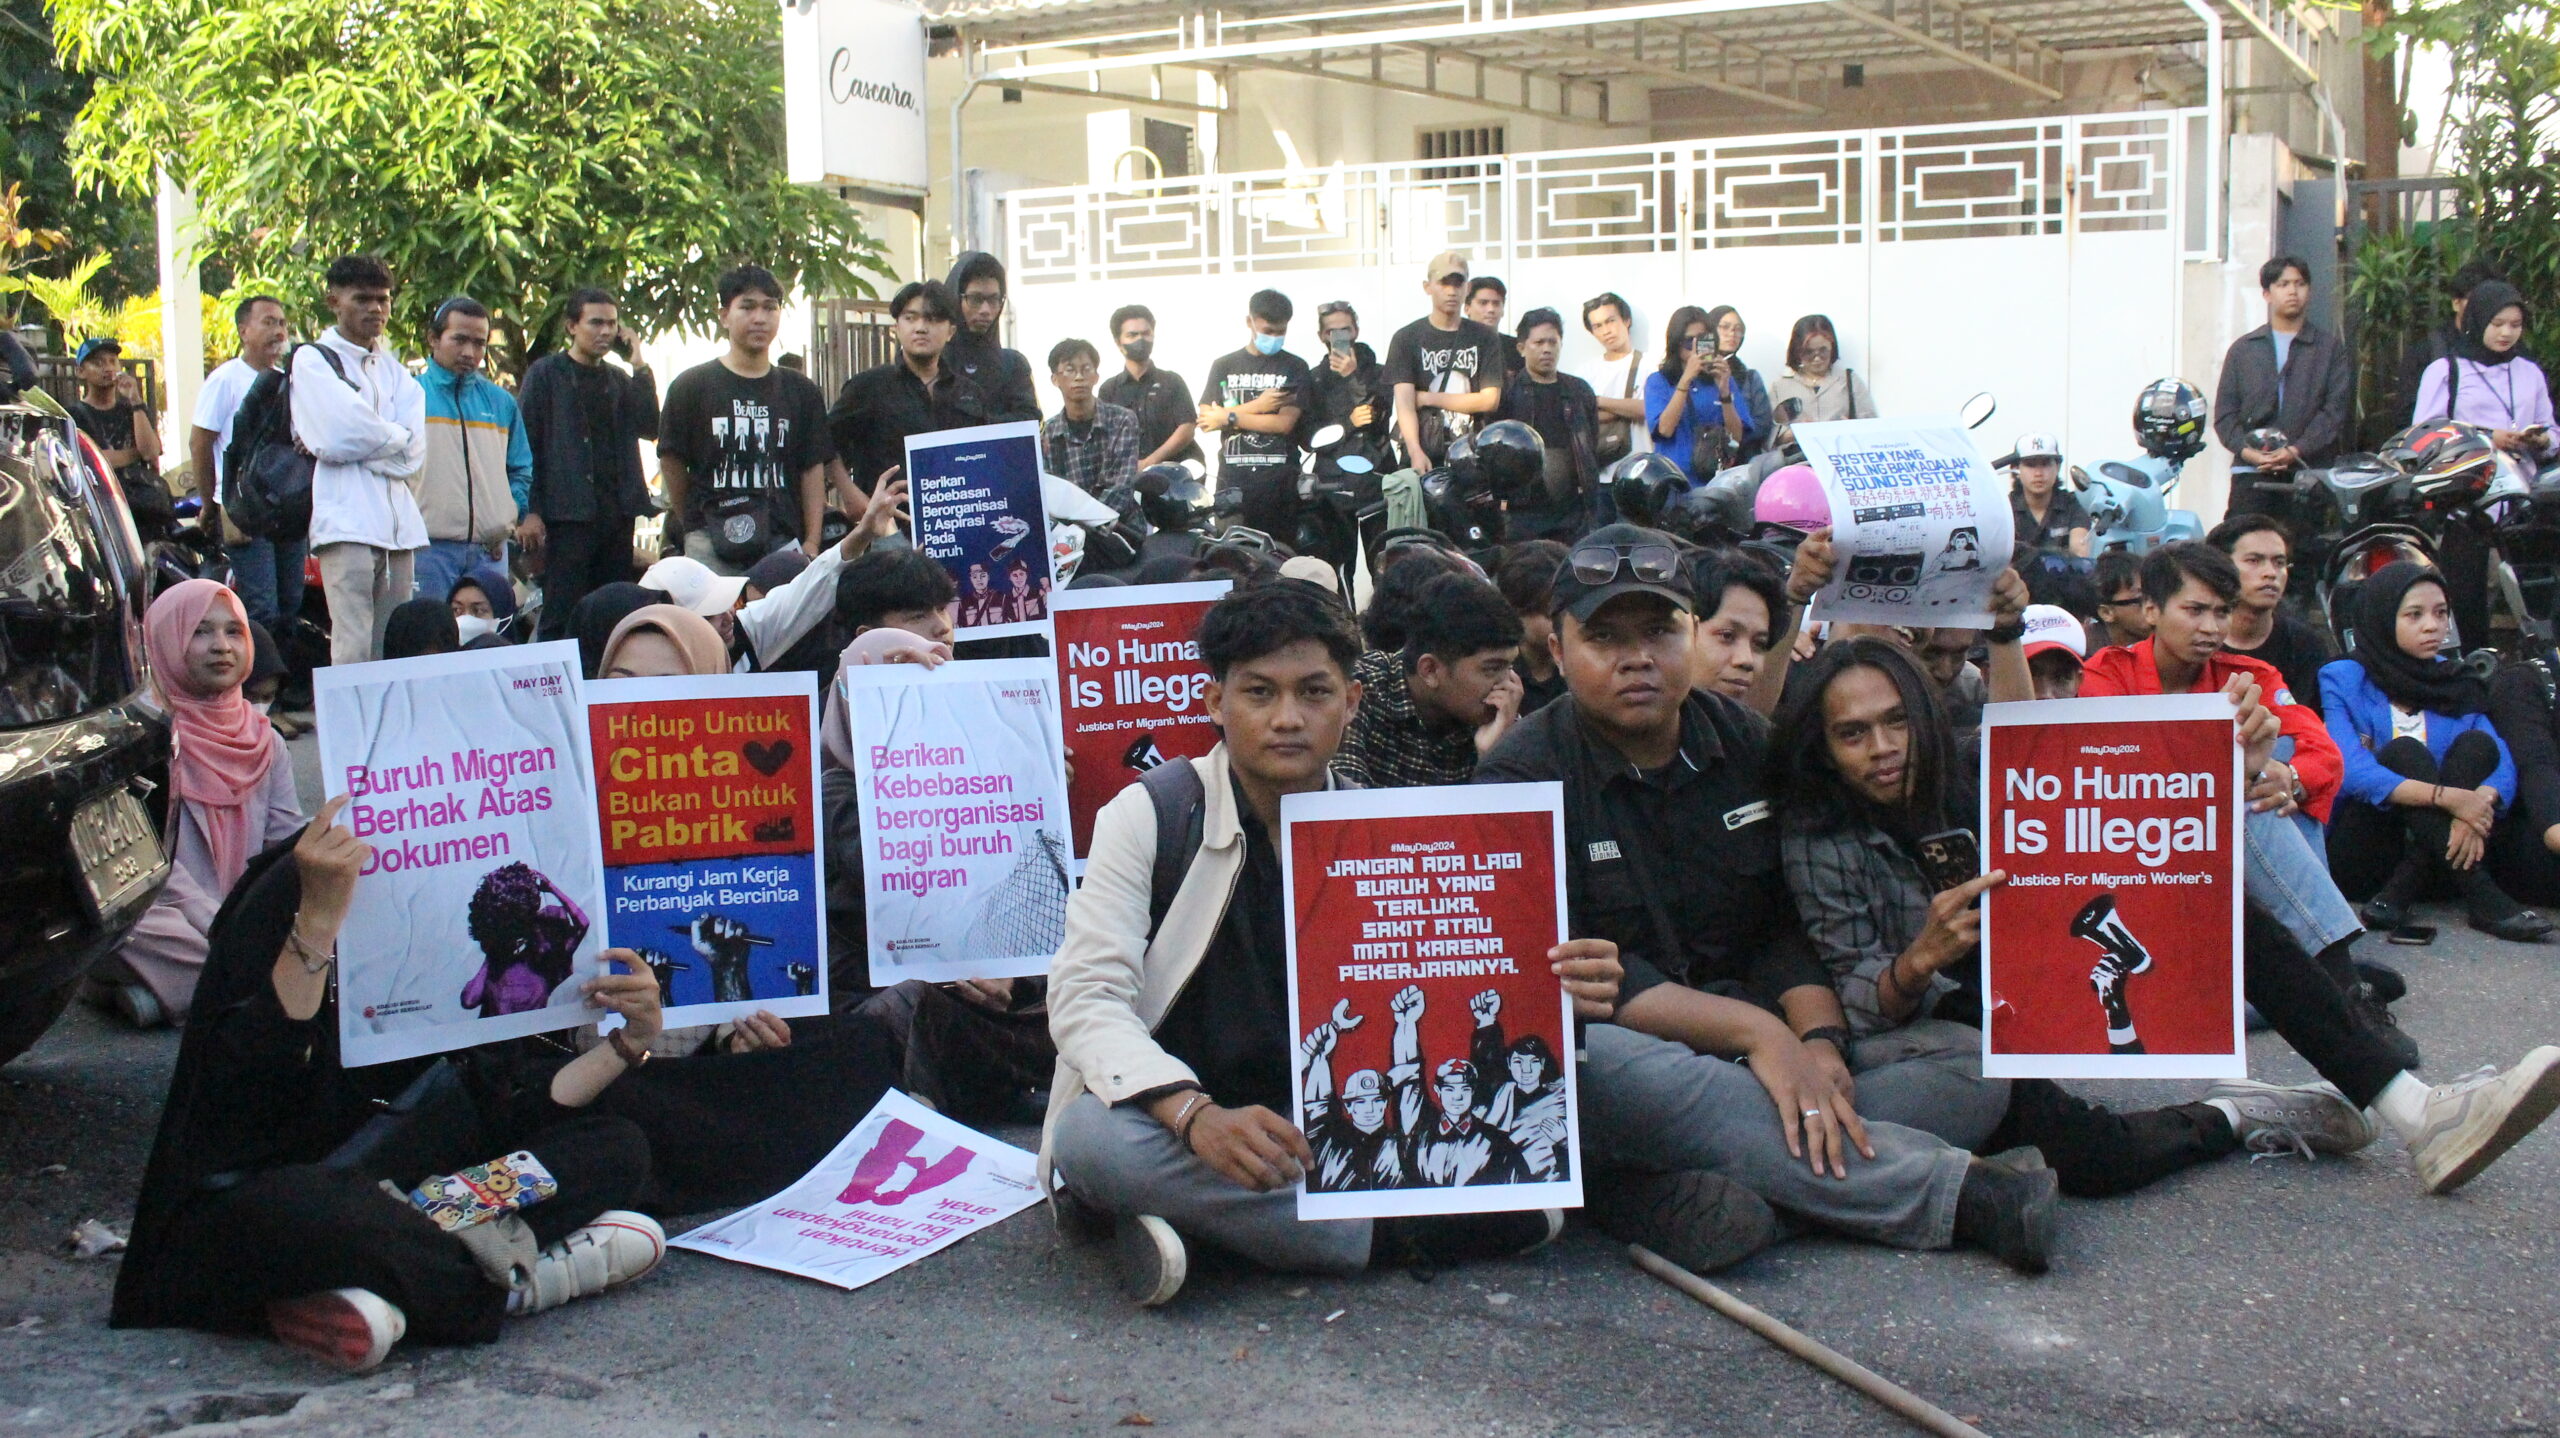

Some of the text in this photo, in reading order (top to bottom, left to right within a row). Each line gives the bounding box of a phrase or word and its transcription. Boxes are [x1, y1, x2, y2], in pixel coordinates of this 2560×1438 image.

[1828, 449, 1925, 466] SYSTEM YANG
[1834, 457, 1970, 478] PALING BAIK ADALAH
[920, 475, 966, 491] Berikan
[1841, 470, 1968, 491] SOUND SYSTEM
[921, 487, 991, 504] Kebebasan
[922, 498, 1008, 518] Berorganisasi
[934, 514, 986, 532] Aspirasi
[925, 532, 956, 545] Pada
[925, 546, 963, 559] Buruh
[1120, 621, 1165, 631] #MayDay2024
[1068, 638, 1200, 668] No Huma
[513, 675, 562, 690] MAY DAY
[542, 686, 563, 697] 2024
[1001, 689, 1041, 698] MAY DAY
[1069, 669, 1213, 712] Is Illega
[608, 709, 791, 741] Hidup Untuk
[1076, 721, 1114, 733] Justice
[1117, 720, 1133, 730] For
[1136, 716, 1175, 730] Migrant
[870, 743, 965, 769] Berikan
[2080, 744, 2140, 756] #MayDay2024
[346, 746, 556, 797] Buruh Migran
[610, 744, 740, 783] Cinta
[873, 772, 1013, 800] Kebebasan
[2005, 766, 2215, 801] No Human
[609, 783, 798, 815] Bukan Untuk
[352, 785, 553, 838] Berhak Atas
[875, 797, 1045, 834] berorganisasi
[611, 813, 749, 850] Pabrik
[2004, 805, 2217, 868] Is Illegal
[358, 831, 510, 877] Dokumen
[879, 830, 1013, 867] bagi buruh
[1391, 841, 1455, 854] #MayDay2024
[1326, 852, 1522, 877] JANGAN ADA LAGI
[623, 866, 790, 892] Kurangi Jam Kerja
[882, 866, 967, 898] migran
[1355, 874, 1495, 897] BURUH YANG
[2008, 870, 2212, 888] Justice For Migrant Worker's
[616, 887, 799, 913] Perbanyak Bercinta
[1373, 896, 1480, 917] TERLUKA,
[1362, 917, 1492, 939] SAKIT ATAU
[1352, 937, 1504, 960] MATI KARENA
[1338, 957, 1520, 982] PEKERJAANNYA.
[927, 1211, 975, 1226] dan
[938, 1197, 998, 1216] anak
[772, 1207, 934, 1247] penangkapan
[841, 1209, 956, 1239] Ibu hamil
[797, 1228, 910, 1259] Hentikan
